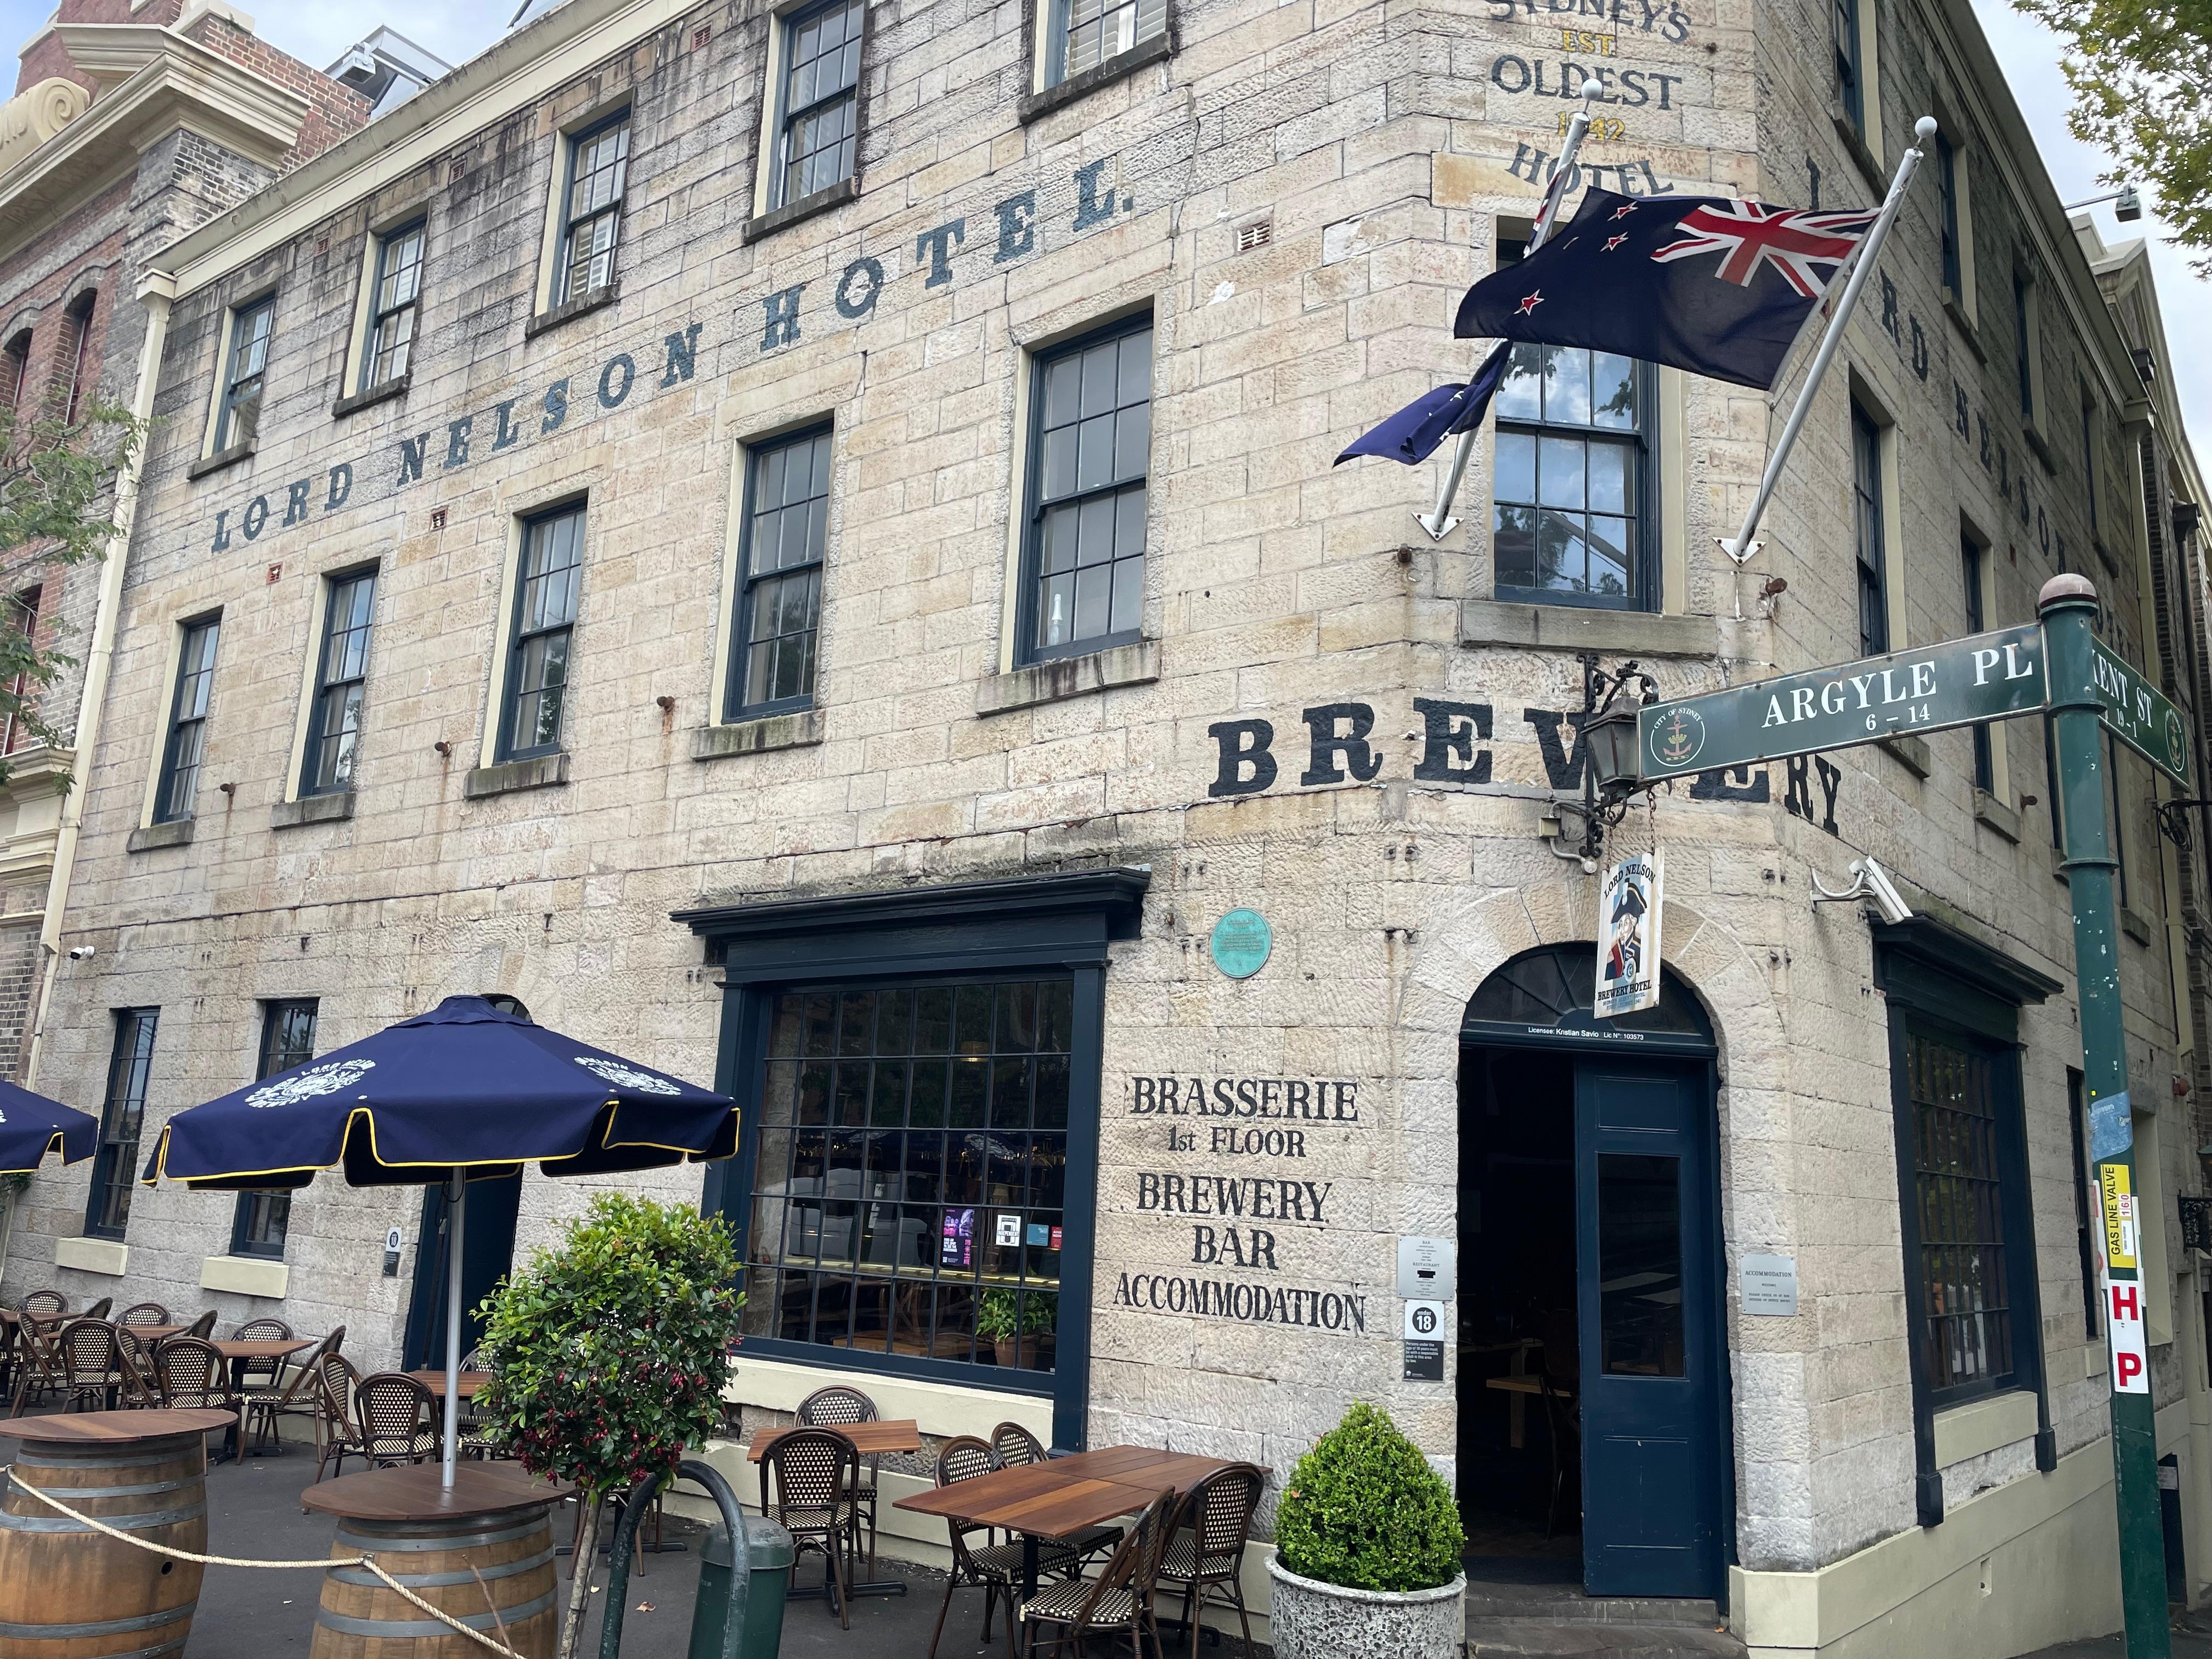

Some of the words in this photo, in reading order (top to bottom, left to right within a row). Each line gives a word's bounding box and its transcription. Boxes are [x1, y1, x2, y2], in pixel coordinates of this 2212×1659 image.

[1562, 29, 1616, 56] EST.
[1491, 55, 1682, 110] OLDEST
[1556, 110, 1625, 142] 142
[1504, 141, 1674, 198] HOTEL
[211, 461, 353, 552] LORD
[397, 322, 703, 487] NELSON
[1761, 661, 1937, 728] ARGYLE
[1971, 642, 2033, 686] PL
[1654, 714, 1667, 729] CITY
[1678, 707, 1702, 721] SYDNEY
[1865, 713, 1877, 731] 6
[1909, 703, 1931, 724] 14
[2136, 686, 2153, 729] ST
[1604, 870, 1623, 900] LORD
[1625, 864, 1656, 884] NELSON
[1598, 985, 1629, 1001] BREWERY
[1629, 979, 1652, 994] HOTEL
[1528, 1026, 1555, 1035] Licensee:
[1130, 1076, 1359, 1122] BRASSERIE
[1167, 1125, 1197, 1152] 1st
[1209, 1126, 1307, 1158] FLOOR
[1136, 1172, 1333, 1222] BREWERY
[2105, 1167, 2117, 1202] VALVE
[2108, 1204, 2118, 1228] LINE
[2121, 1194, 2130, 1216] 160
[1191, 1224, 1279, 1271] BAR
[2111, 1232, 2120, 1255] GAS
[1113, 1272, 1368, 1333] ACCOMMODATION
[2112, 1286, 2138, 1321] H
[1417, 1316, 1431, 1330] 18
[2117, 1352, 2141, 1387] P
